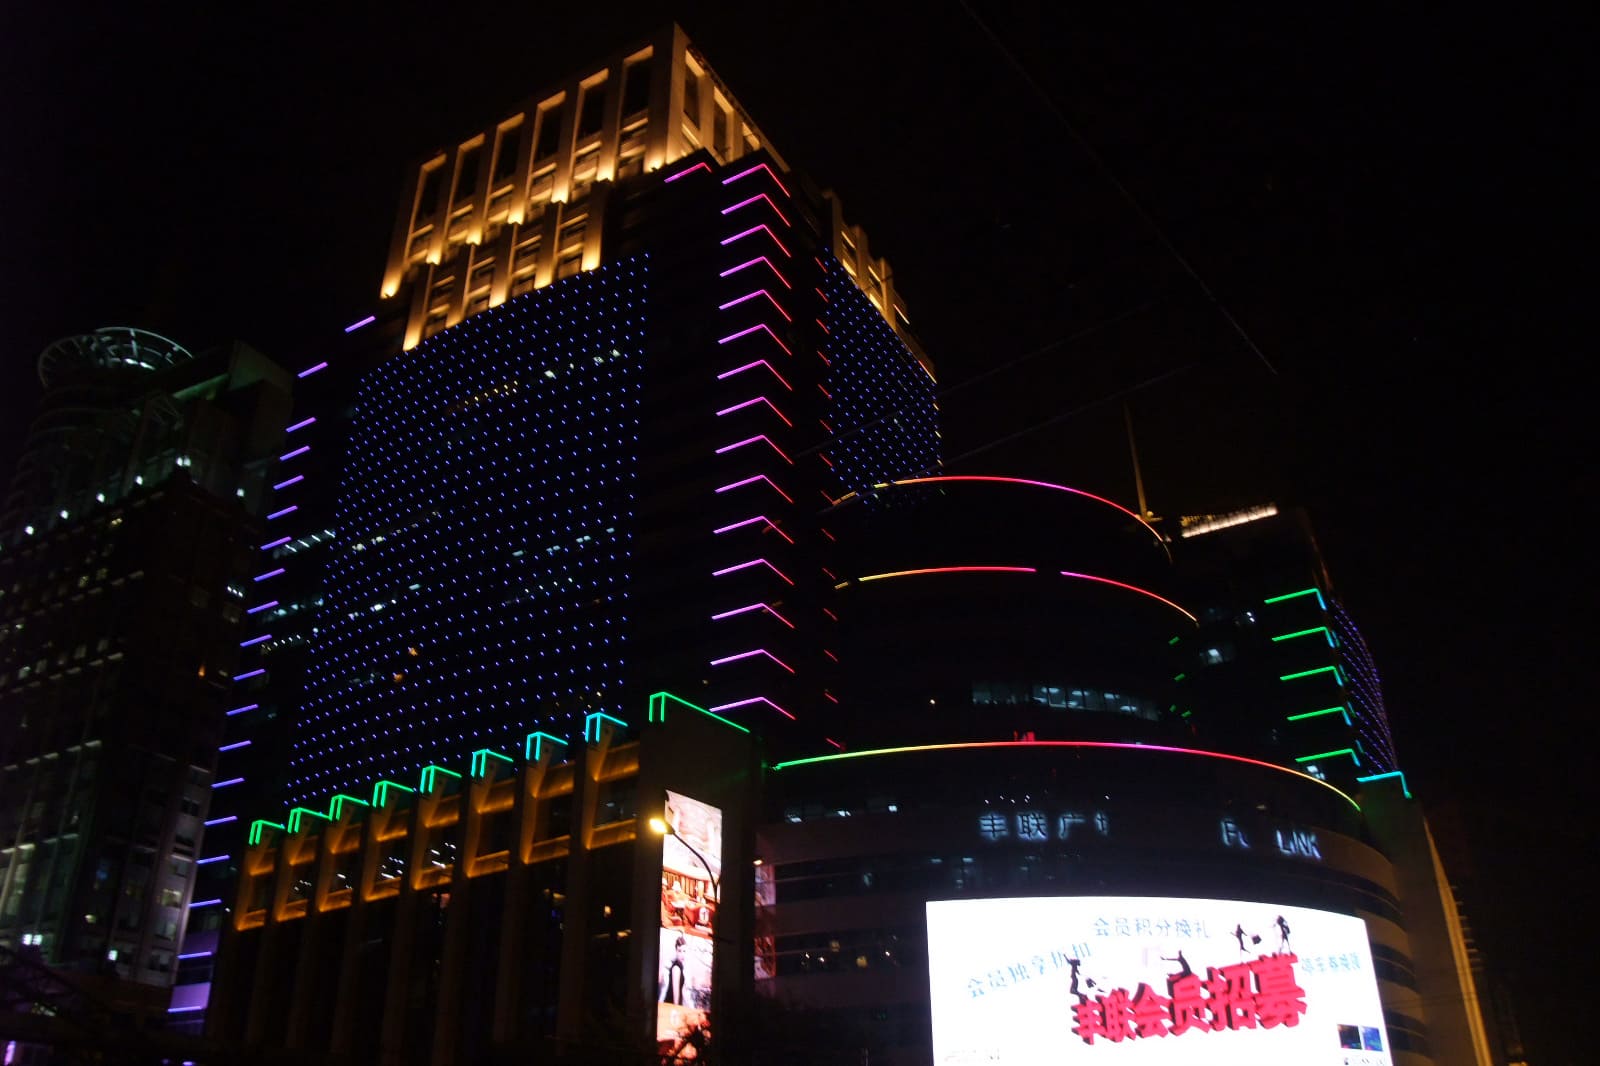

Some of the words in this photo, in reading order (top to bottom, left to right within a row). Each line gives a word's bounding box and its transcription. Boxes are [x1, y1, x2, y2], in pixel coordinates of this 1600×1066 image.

[1070, 952, 1307, 1045] 丰联会员招募
